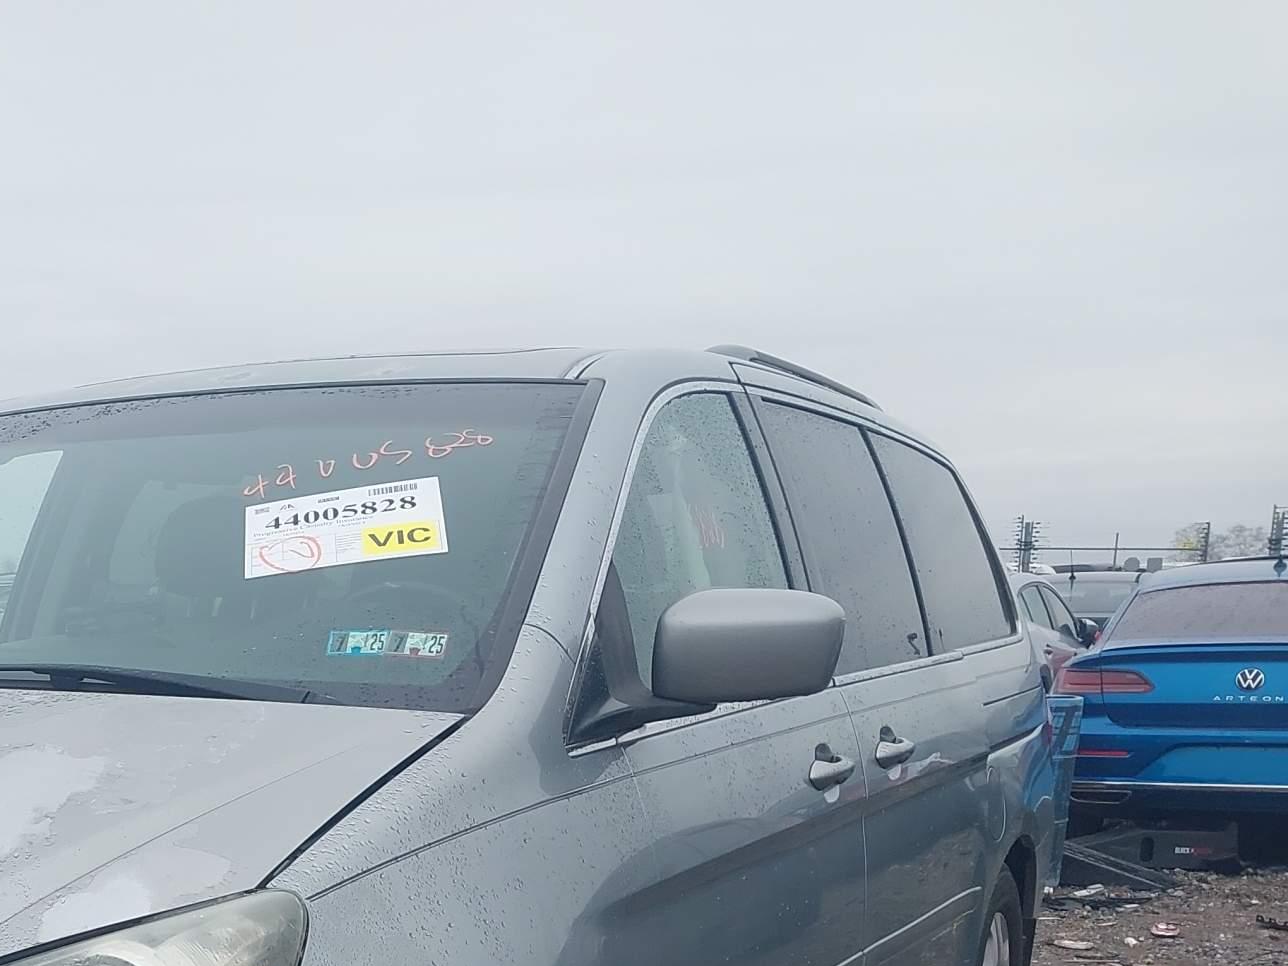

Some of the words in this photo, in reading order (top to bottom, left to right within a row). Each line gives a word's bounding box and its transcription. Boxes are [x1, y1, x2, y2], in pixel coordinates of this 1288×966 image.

[264, 495, 417, 530] 44005828
[368, 527, 432, 548] VIC
[369, 633, 386, 651] 25
[428, 635, 446, 654] 25
